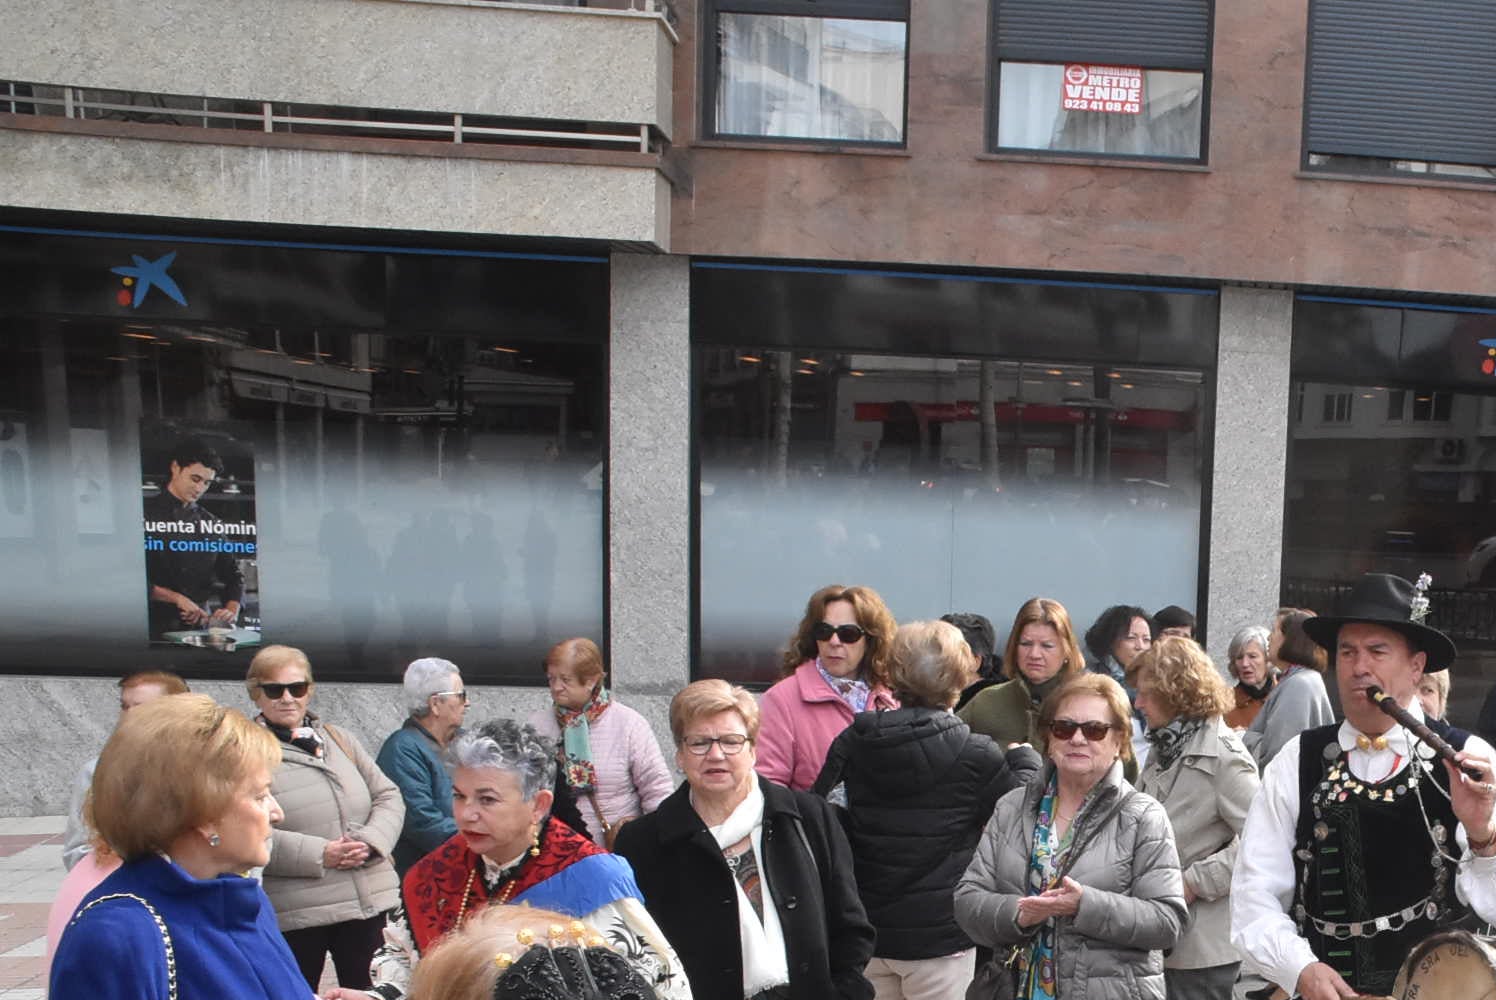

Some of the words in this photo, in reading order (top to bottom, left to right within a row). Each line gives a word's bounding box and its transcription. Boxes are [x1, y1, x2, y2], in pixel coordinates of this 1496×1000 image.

[1088, 75, 1141, 88] METRO
[1066, 84, 1140, 102] VENDE
[1064, 99, 1088, 109] 923
[1090, 101, 1103, 111] 41
[144, 519, 195, 533] uenta
[169, 538, 257, 553] comisione
[1421, 953, 1441, 974] SRA
